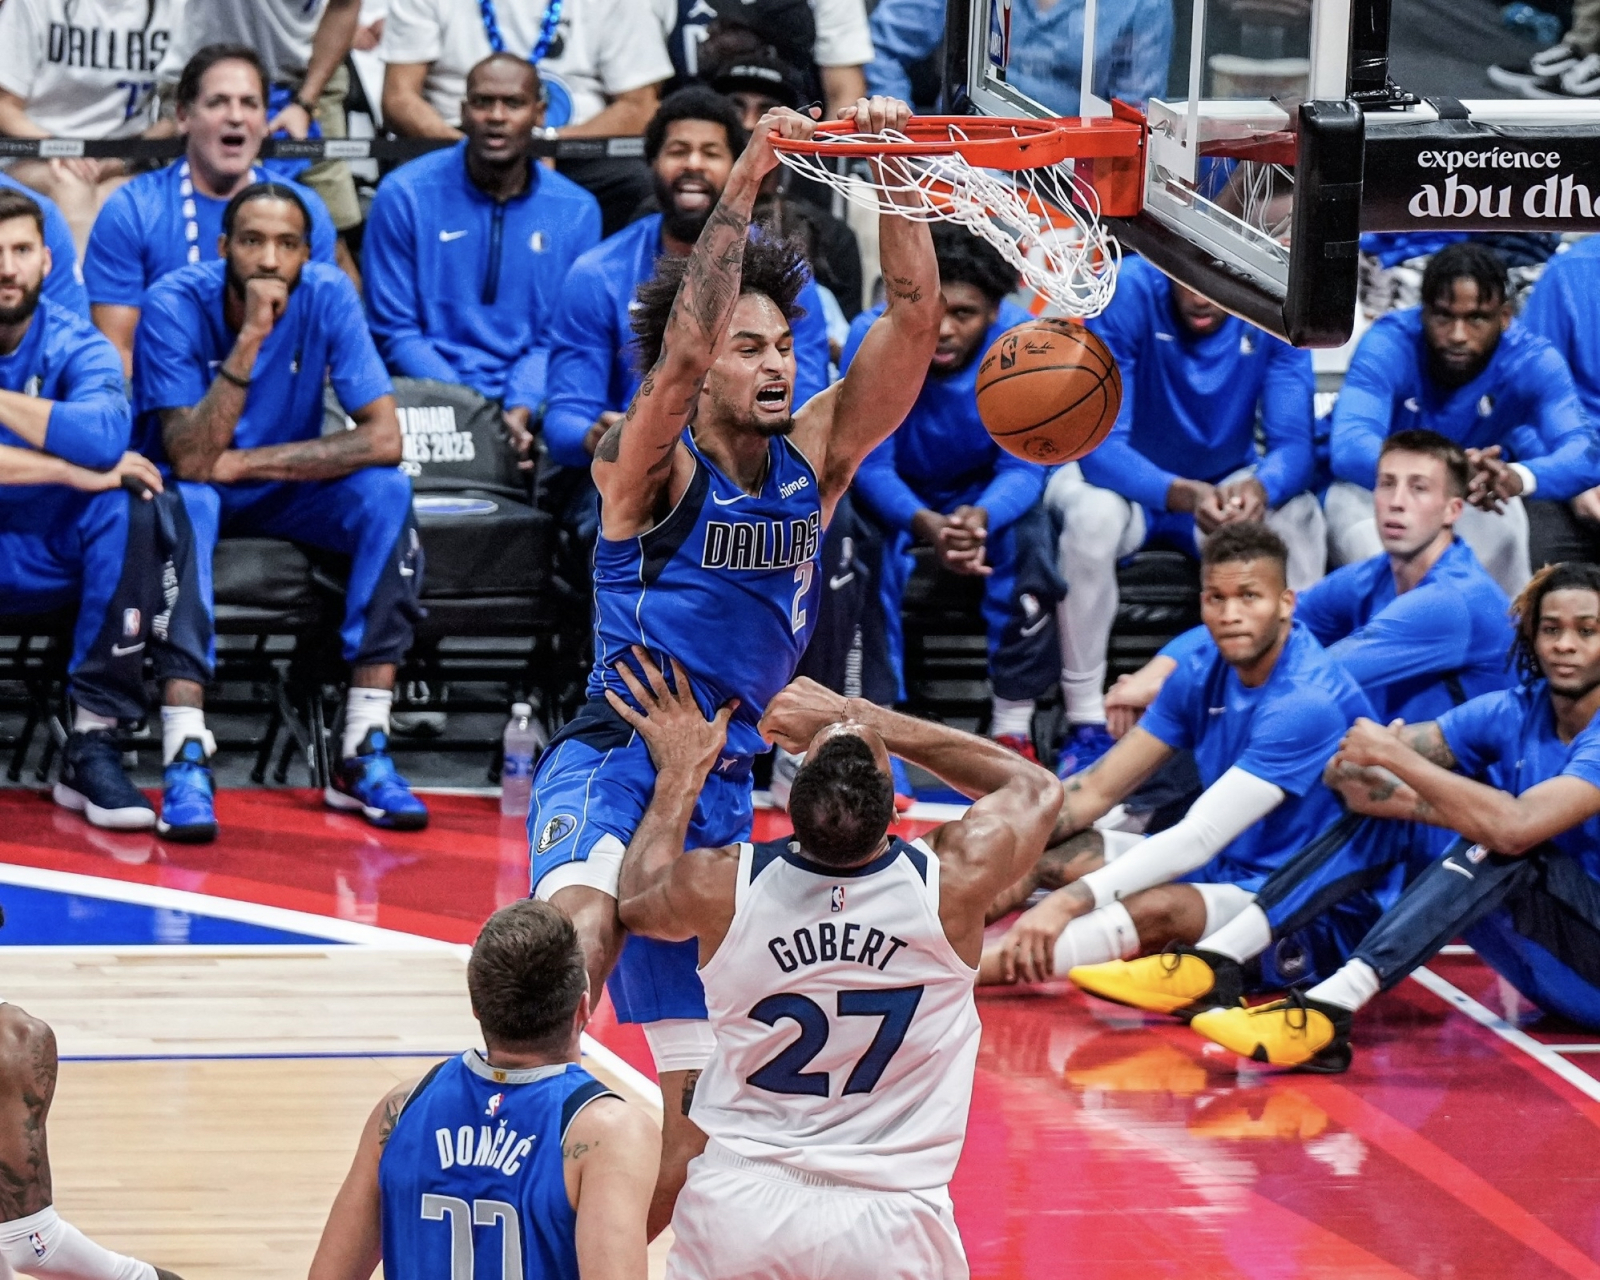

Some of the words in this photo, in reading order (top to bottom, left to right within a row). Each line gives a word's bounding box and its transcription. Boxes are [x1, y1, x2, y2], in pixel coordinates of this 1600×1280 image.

[48, 22, 170, 71] DALLAS
[1408, 173, 1513, 218] abu
[1522, 173, 1600, 218] dh
[431, 431, 475, 462] 2023
[778, 475, 810, 500] hime
[701, 510, 820, 570] DALLAS
[791, 561, 814, 636] 2
[767, 922, 909, 974] GOBERT
[746, 984, 925, 1099] 27
[435, 1119, 537, 1177] DONČIĆ
[420, 1193, 524, 1280] 77
